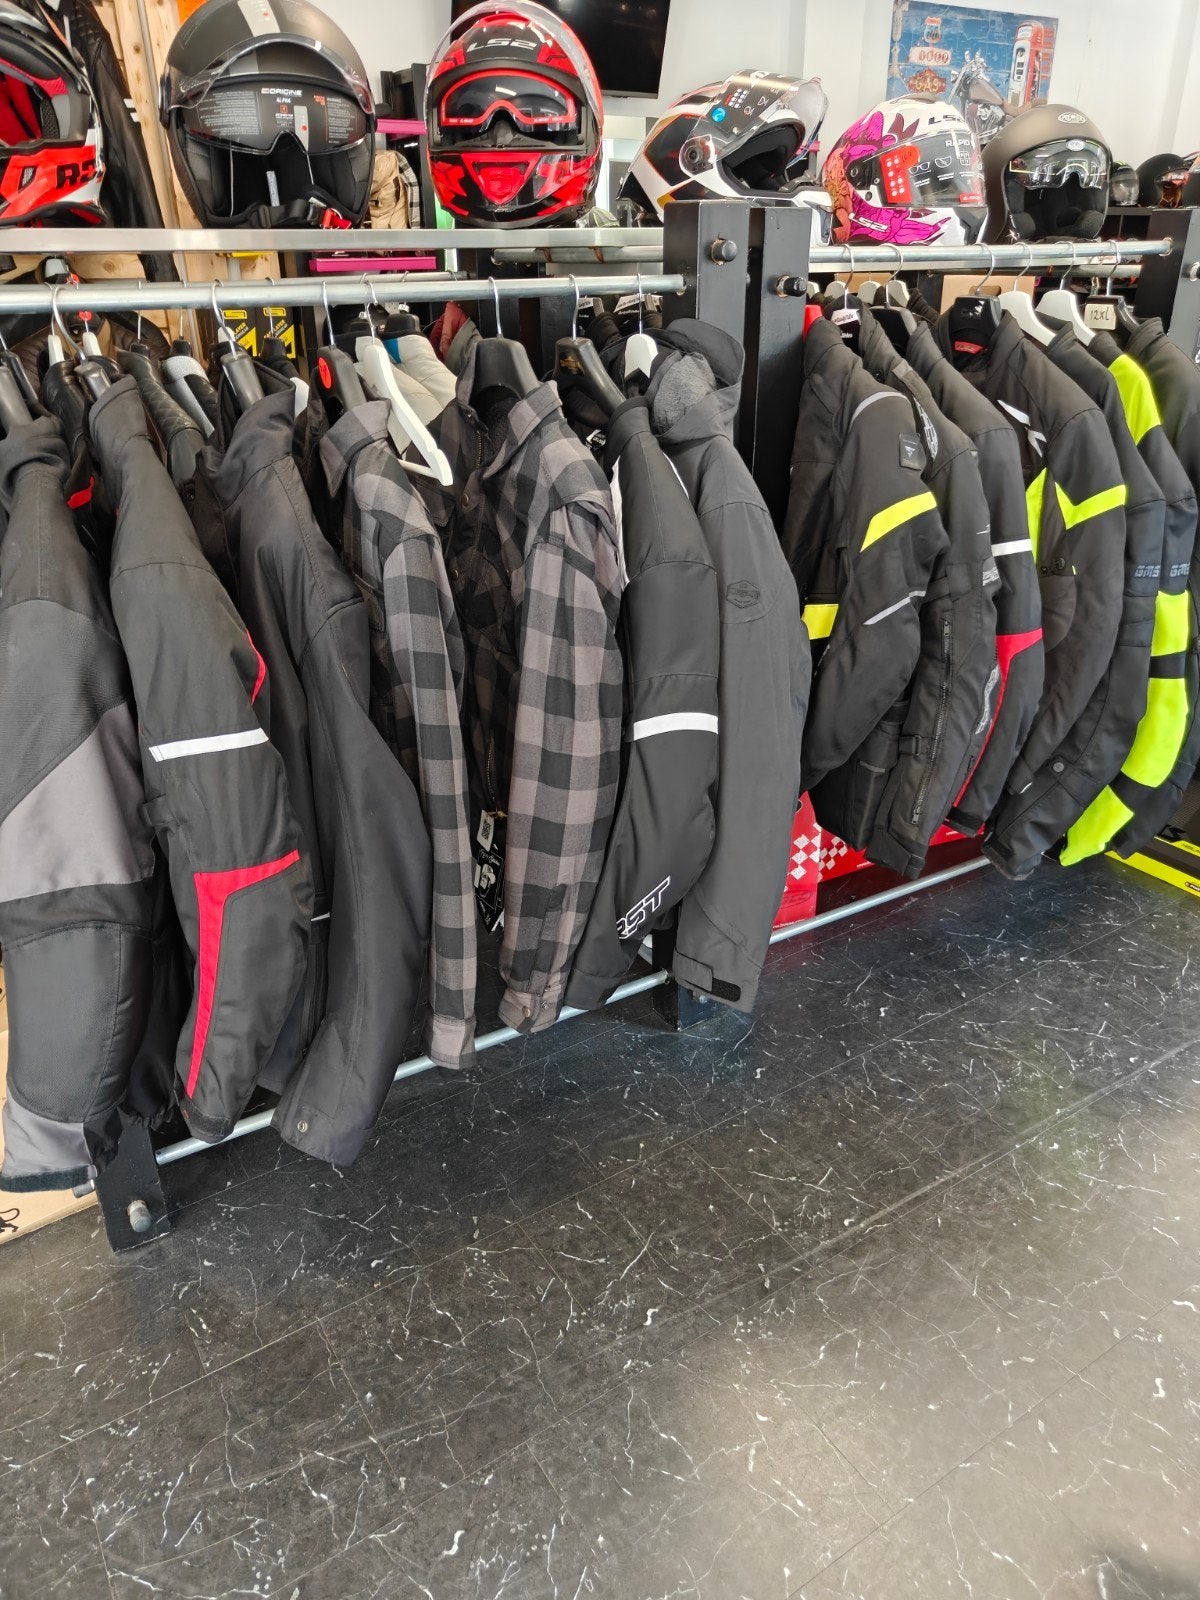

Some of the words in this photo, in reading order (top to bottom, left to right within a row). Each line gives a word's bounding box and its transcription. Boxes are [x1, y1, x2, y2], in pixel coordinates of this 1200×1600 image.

[466, 38, 538, 52] LS2
[915, 75, 940, 92] GAS
[269, 88, 303, 96] ORIGINE
[849, 212, 888, 232] LS2
